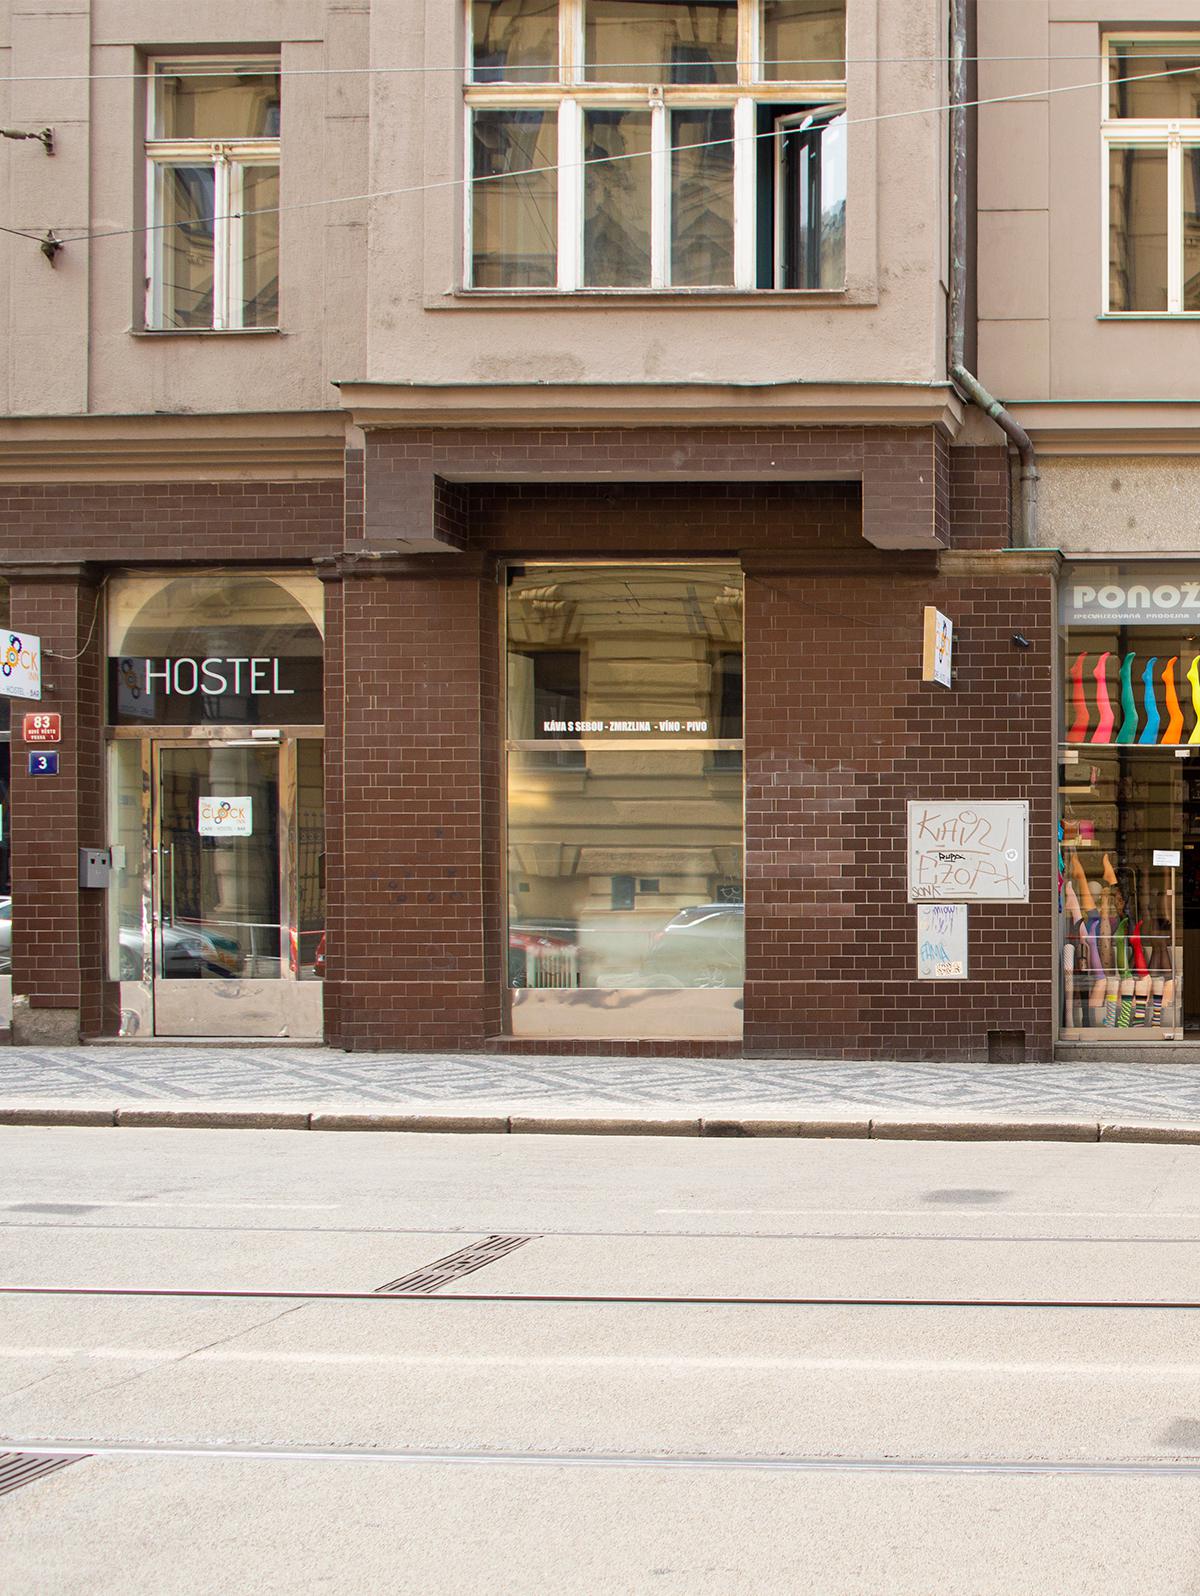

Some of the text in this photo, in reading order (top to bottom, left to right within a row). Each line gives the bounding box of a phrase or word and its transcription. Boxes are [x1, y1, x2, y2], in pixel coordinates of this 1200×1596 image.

[145, 658, 295, 696] HOSTEL
[34, 716, 51, 729] 83
[543, 719, 567, 732] KÁVA
[567, 722, 574, 732] S
[575, 722, 604, 732] SEBOU
[609, 722, 651, 732] ZMRZLINA
[659, 719, 681, 732] VÍNO
[686, 721, 708, 732] PIVO
[38, 756, 48, 770] 3
